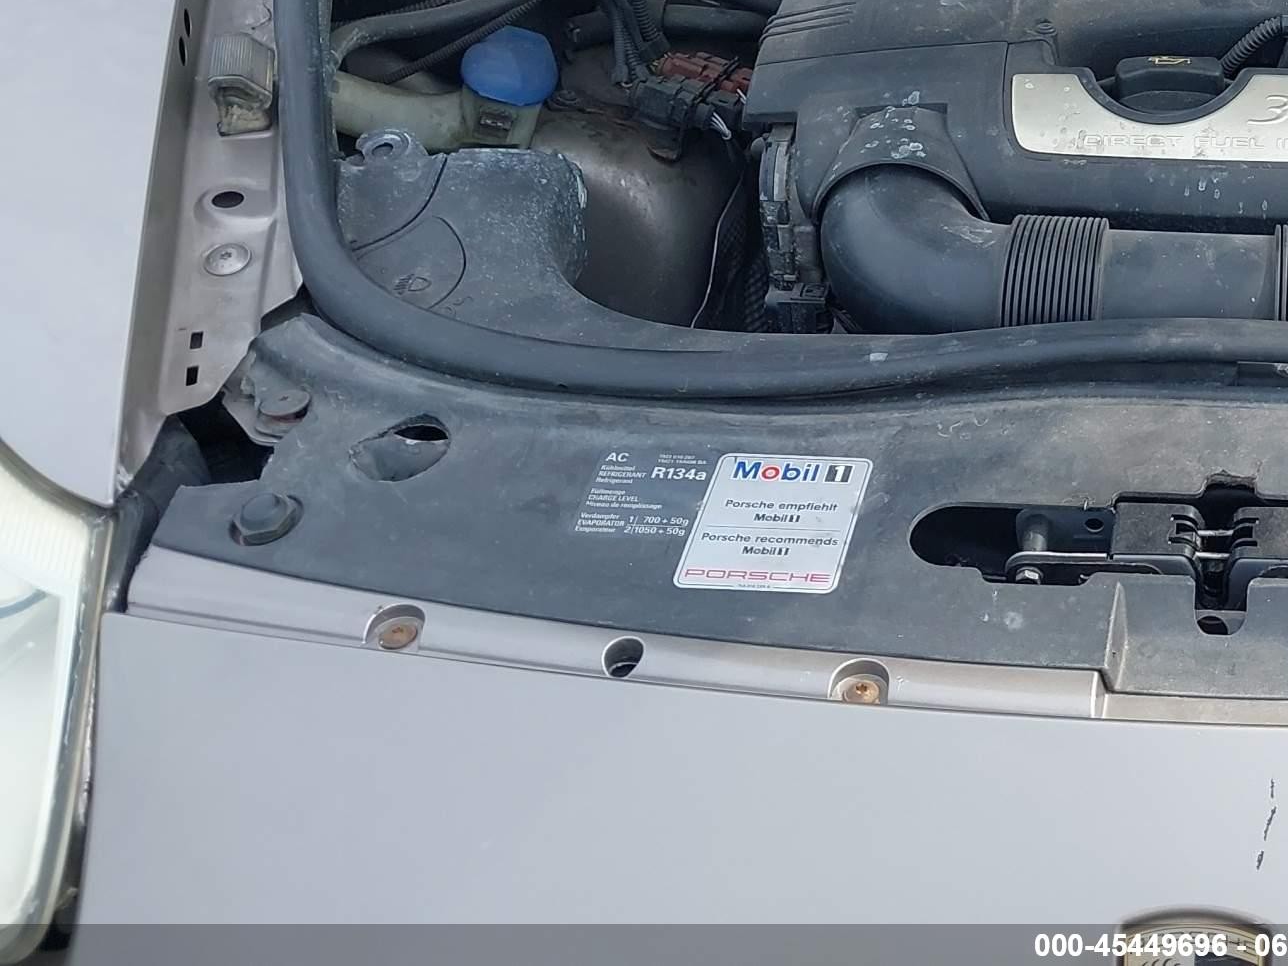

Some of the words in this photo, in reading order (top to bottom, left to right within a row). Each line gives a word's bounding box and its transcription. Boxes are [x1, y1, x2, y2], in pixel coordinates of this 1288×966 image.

[1083, 134, 1185, 147] DIRECT
[1193, 135, 1265, 149] FUEL
[605, 452, 630, 462] AC
[651, 466, 708, 480] R134a
[732, 461, 821, 482] Mobil
[724, 499, 775, 510] Porsche
[778, 501, 838, 512] empfiehlt
[669, 517, 689, 526] 50g
[666, 527, 686, 536] 50g
[701, 532, 751, 543] Porsche
[754, 536, 839, 546] recommends
[684, 568, 832, 583] PORSCHE
